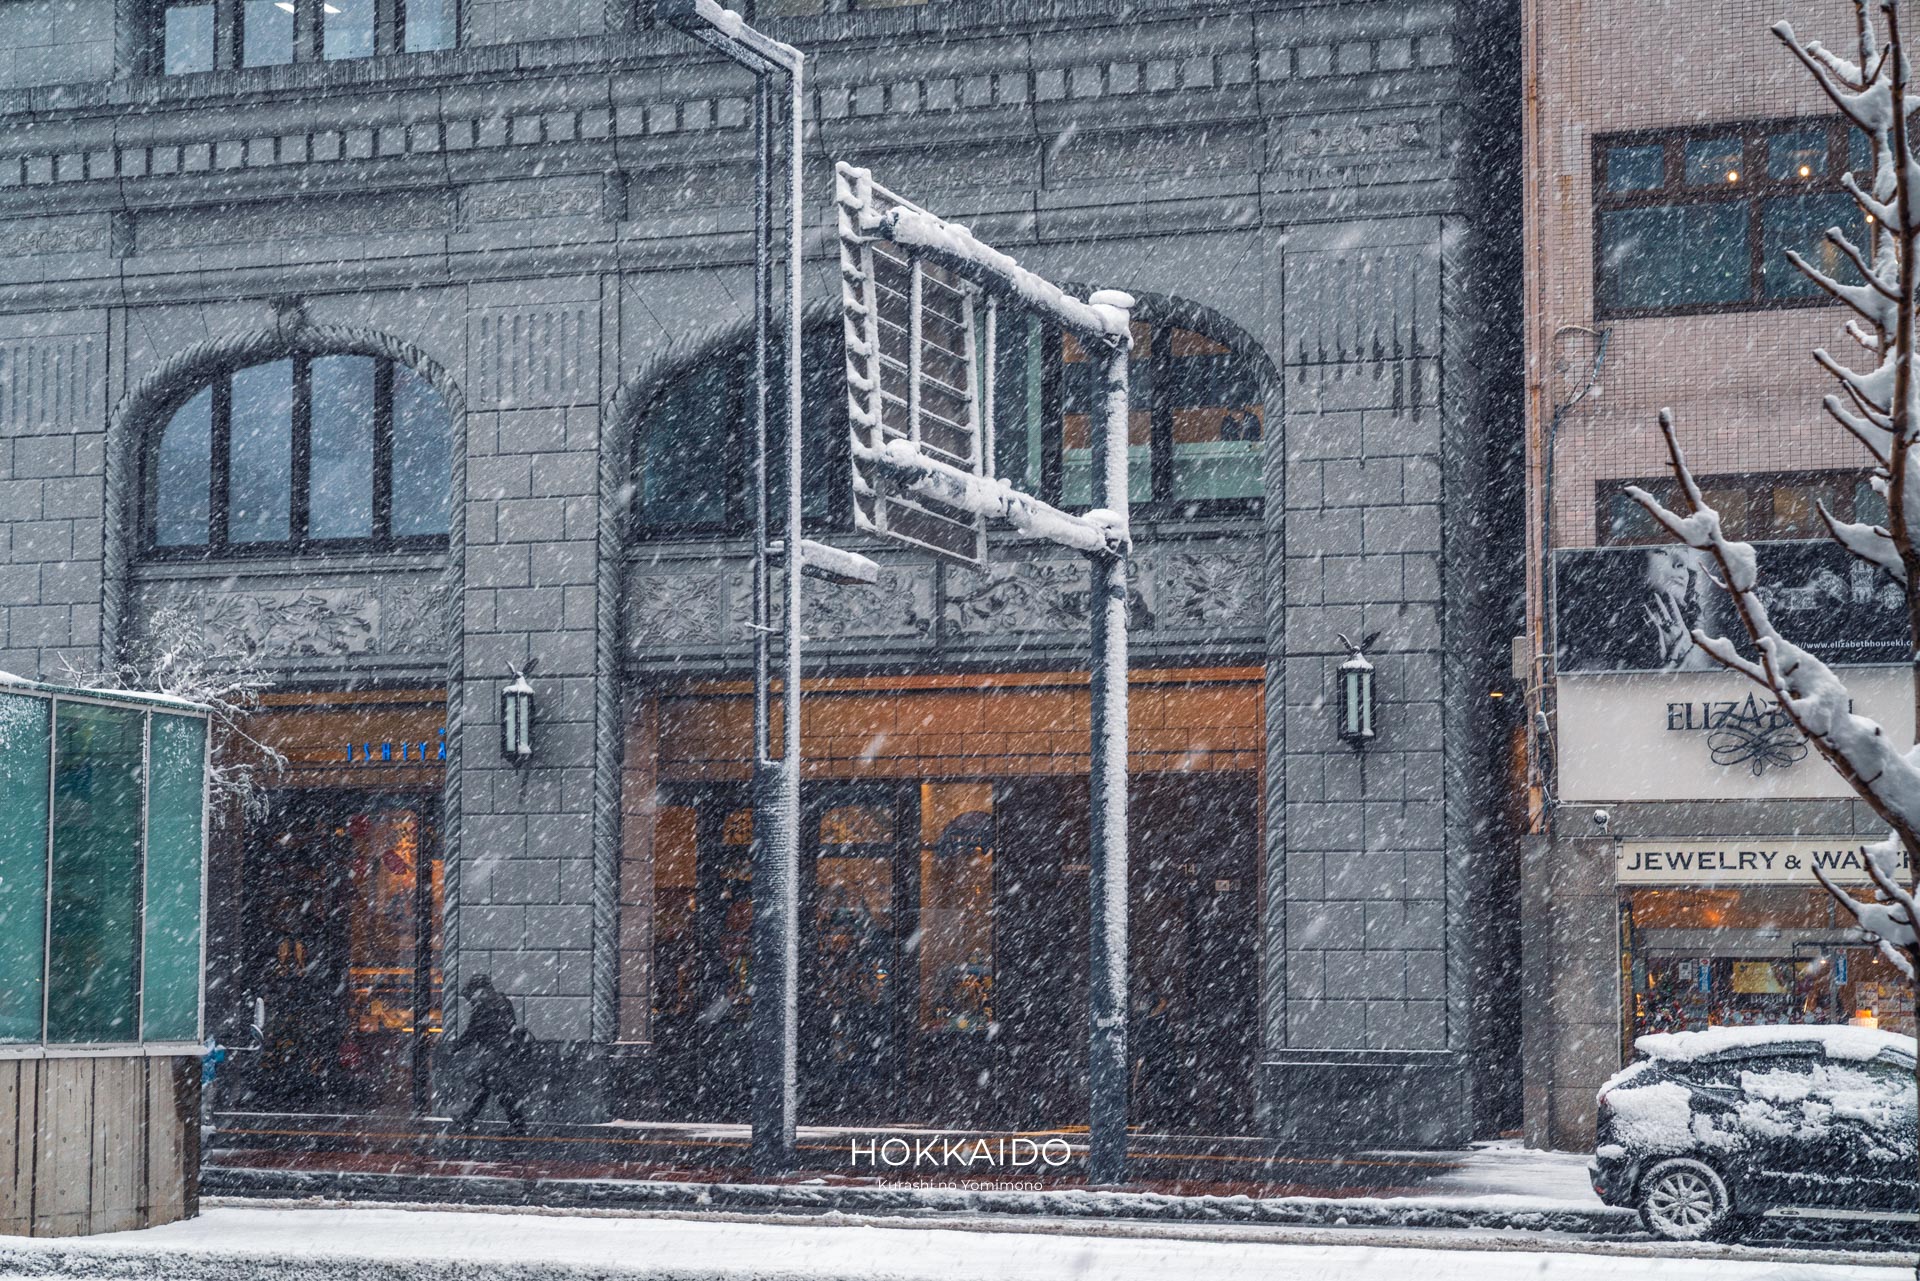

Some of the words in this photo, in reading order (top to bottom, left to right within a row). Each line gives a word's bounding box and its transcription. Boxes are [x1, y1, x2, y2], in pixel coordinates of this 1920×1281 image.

[347, 741, 447, 763] ISHIYA
[1626, 851, 1779, 871] JEWELRY
[1784, 854, 1802, 870] &
